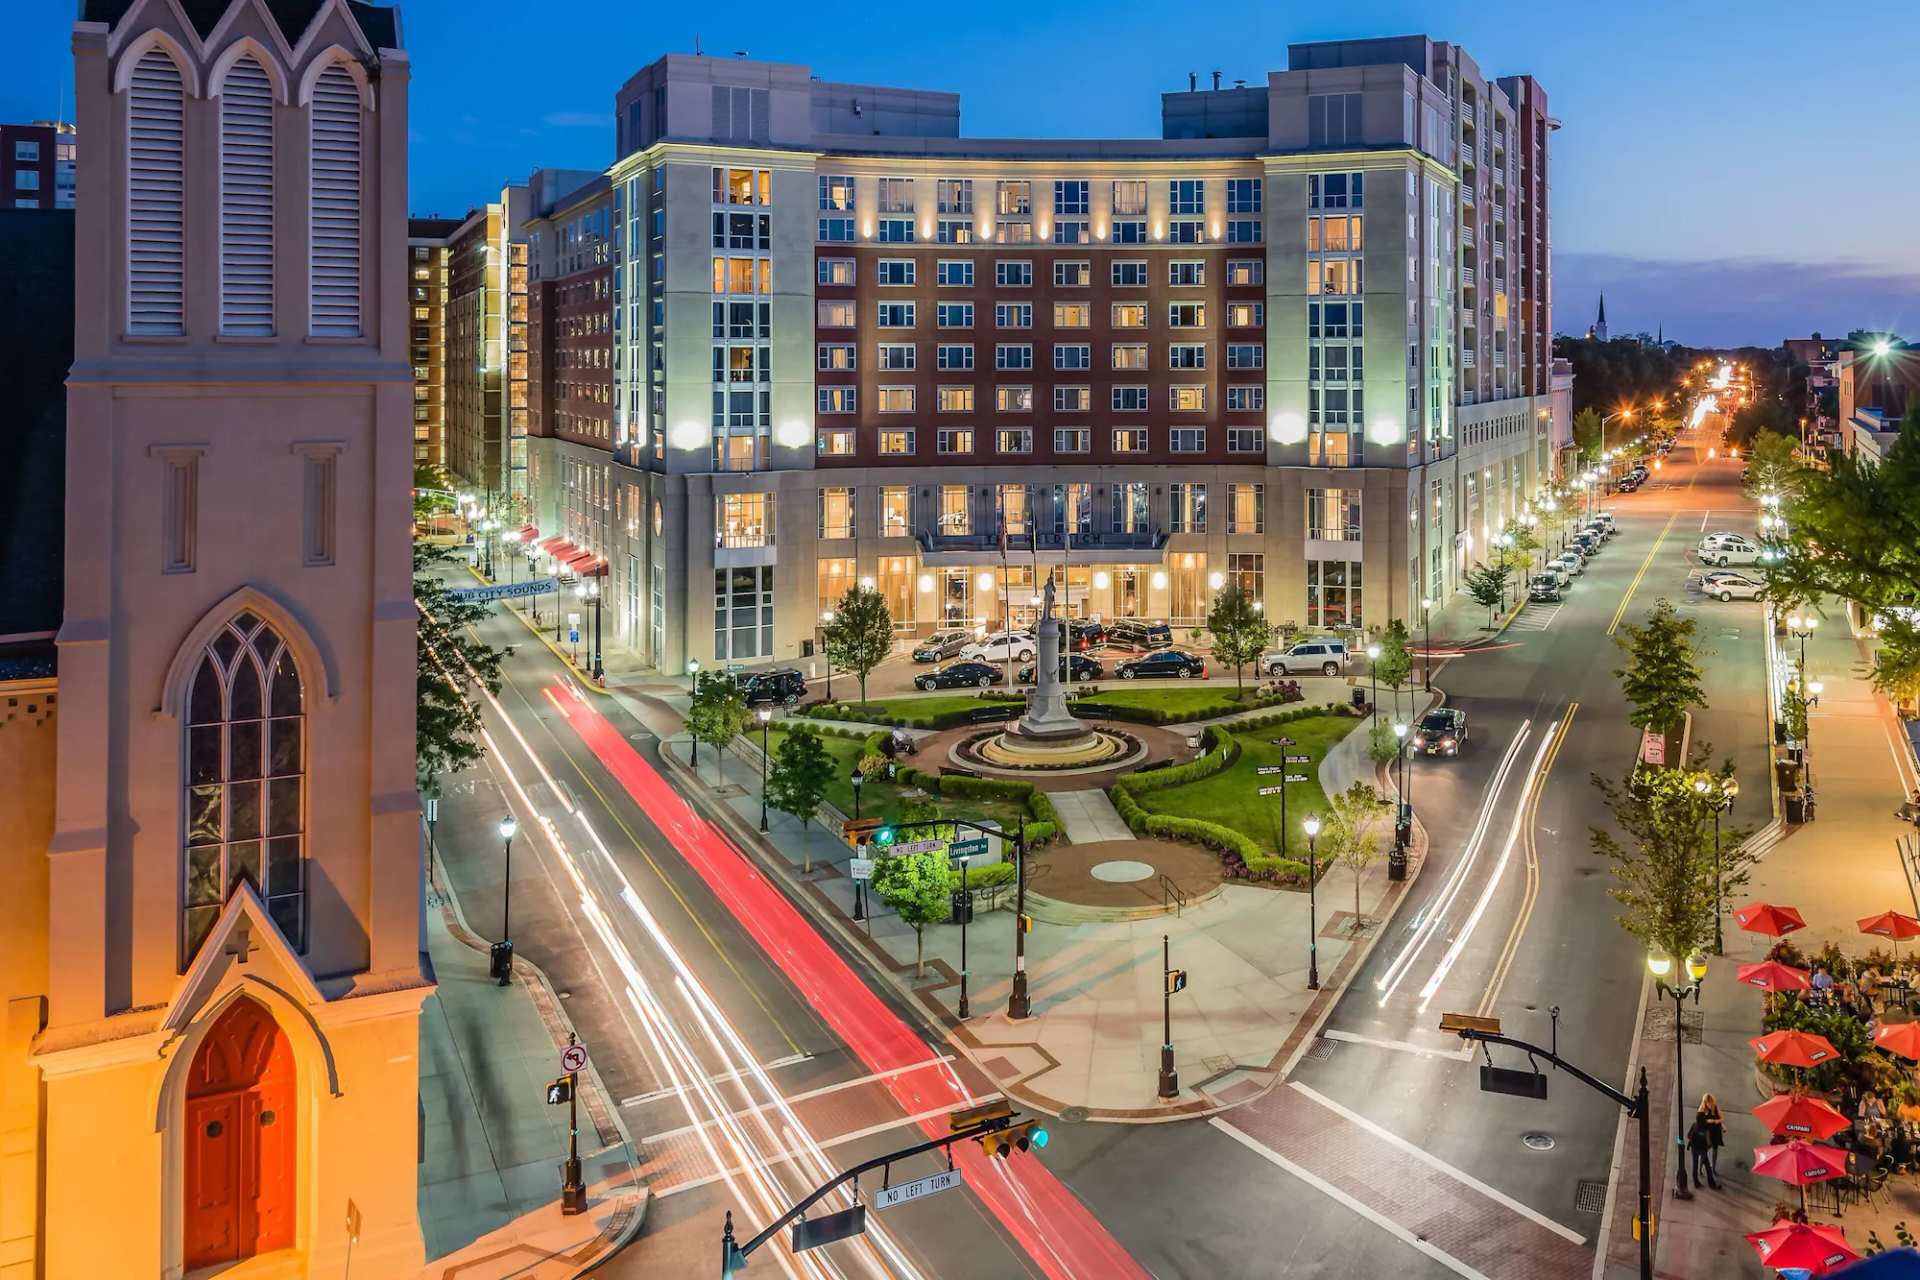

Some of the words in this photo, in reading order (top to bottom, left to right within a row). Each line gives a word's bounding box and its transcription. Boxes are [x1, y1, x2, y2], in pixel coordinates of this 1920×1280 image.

[986, 535, 1013, 544] TE
[1024, 534, 1101, 544] HLDICH
[479, 589, 503, 599] CITY
[506, 582, 551, 596] SOUNDS
[950, 844, 979, 857] Livingston
[887, 1191, 899, 1203] NO
[906, 1183, 924, 1197] LEFT
[930, 1175, 951, 1190] TURN
